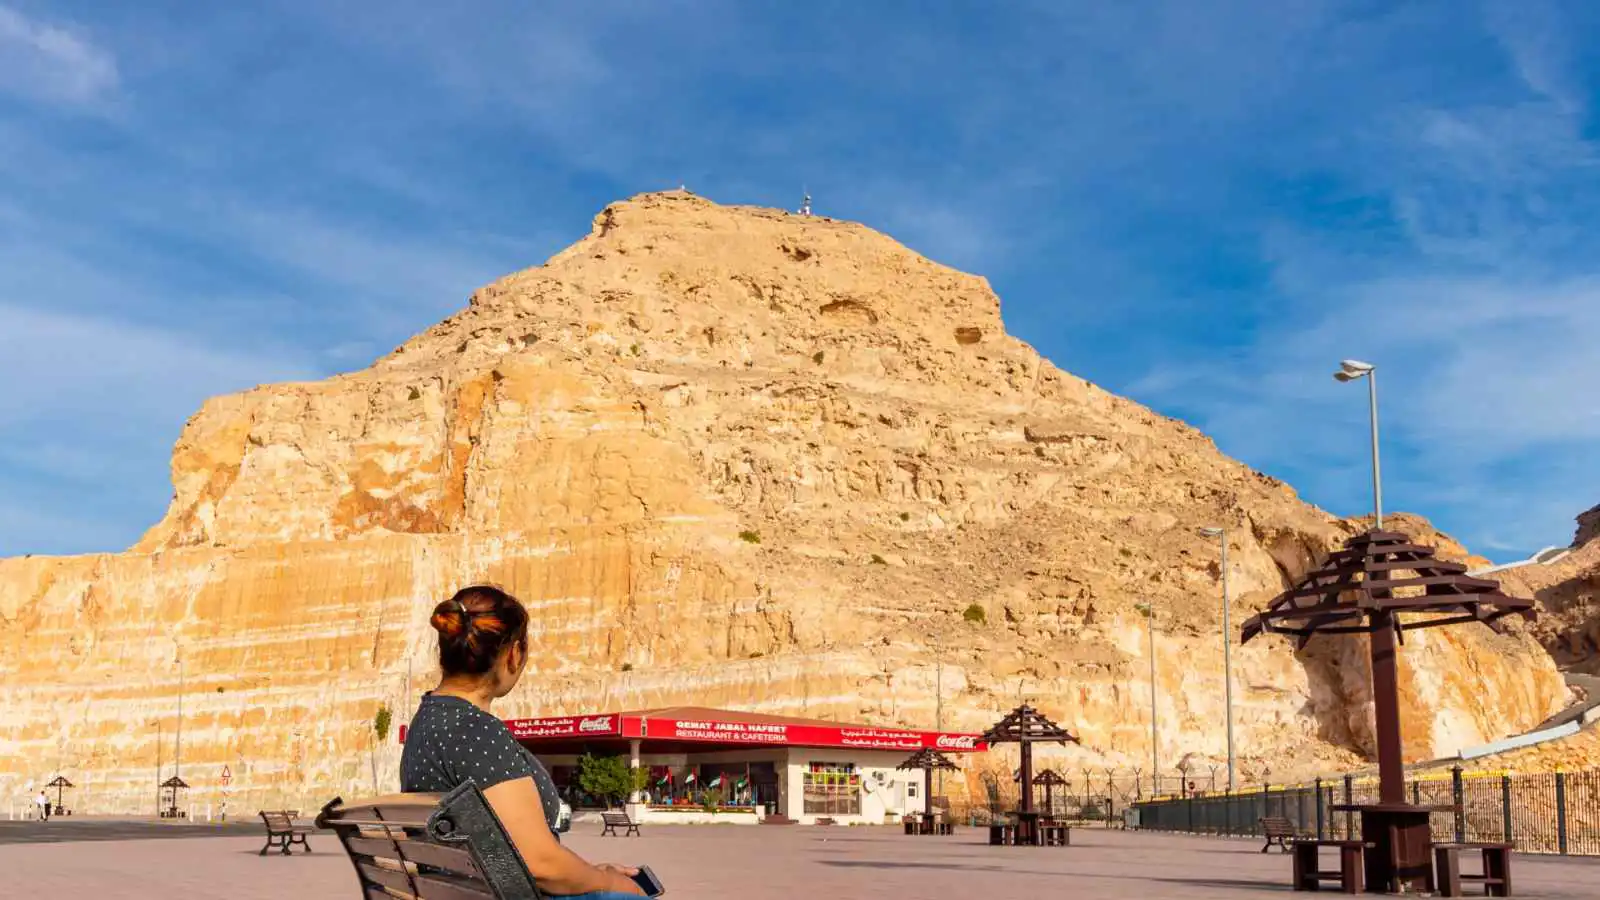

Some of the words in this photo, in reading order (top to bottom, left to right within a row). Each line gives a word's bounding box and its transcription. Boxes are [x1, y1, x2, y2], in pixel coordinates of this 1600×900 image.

[715, 723, 746, 731] JABAL
[676, 730, 731, 739] RESTAURANT
[742, 733, 787, 741] CAFETERIA
